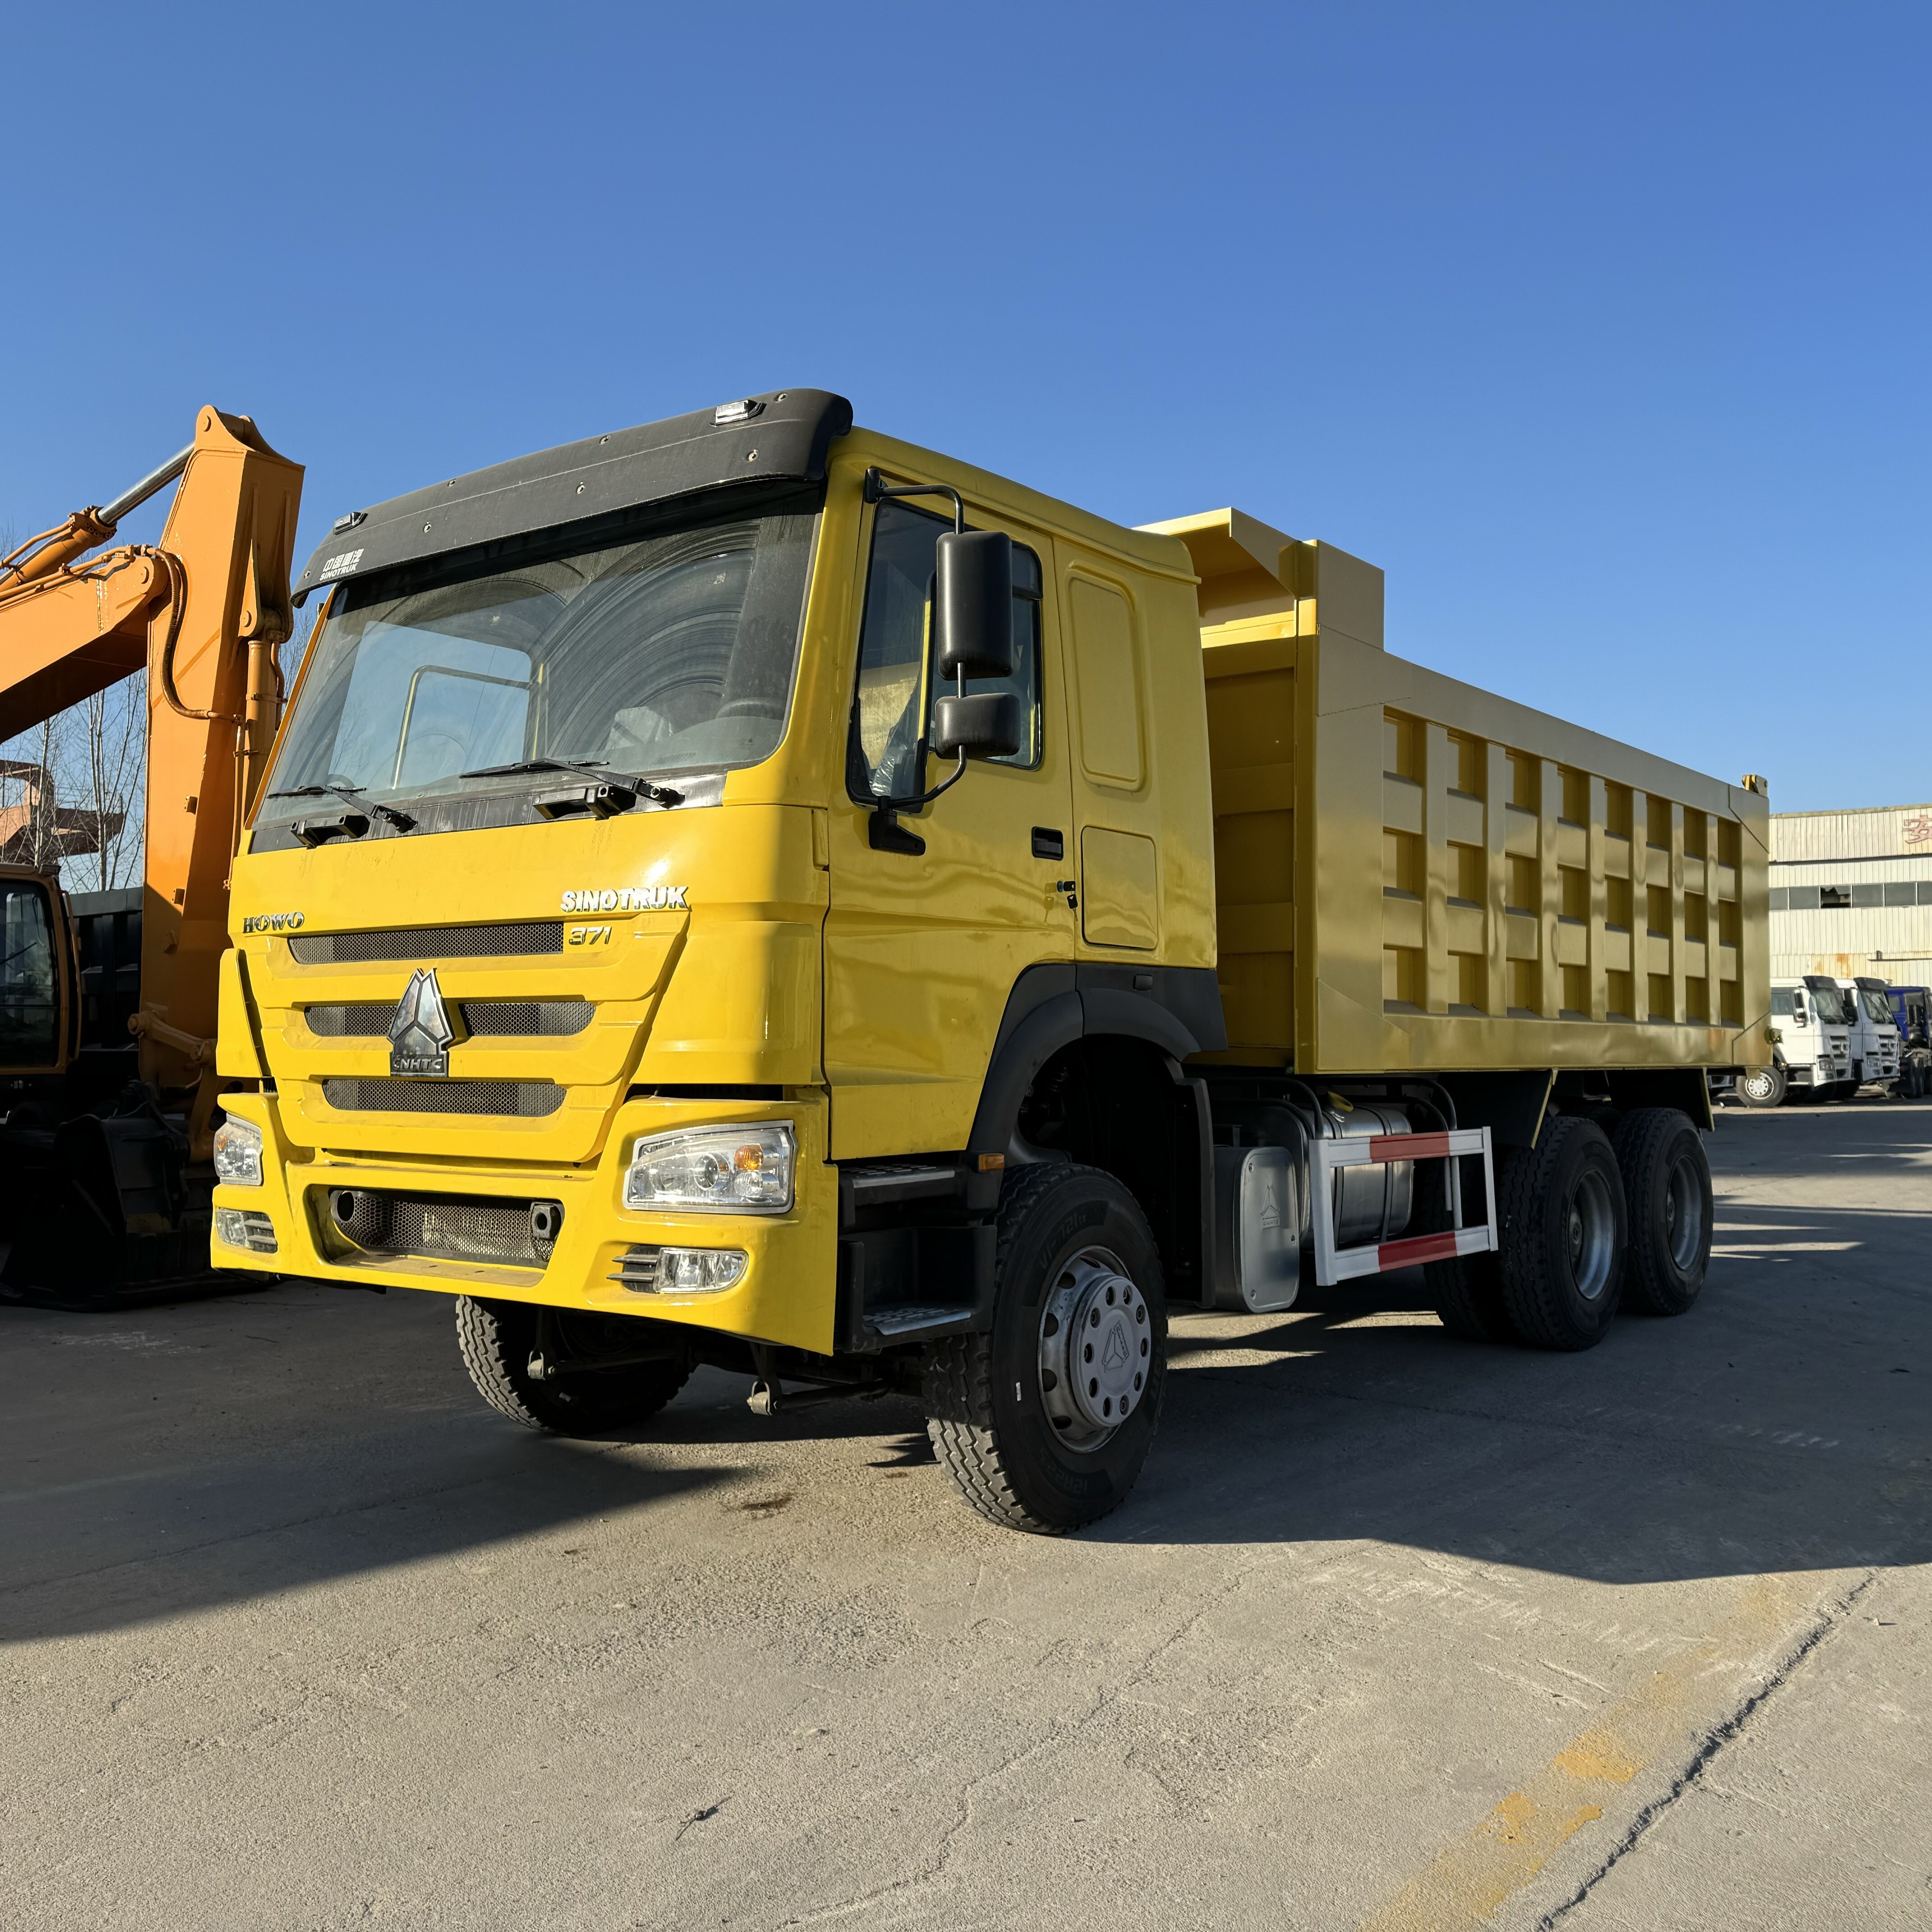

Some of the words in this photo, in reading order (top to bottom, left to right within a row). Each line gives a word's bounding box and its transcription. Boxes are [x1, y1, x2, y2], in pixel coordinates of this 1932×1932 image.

[322, 548, 364, 572] 中国重汽
[319, 562, 358, 581] SINOTRUK
[560, 886, 689, 912] SINOTRUK
[242, 911, 305, 934] HOWO
[568, 926, 612, 945] 371
[393, 1058, 443, 1070] CNHTC
